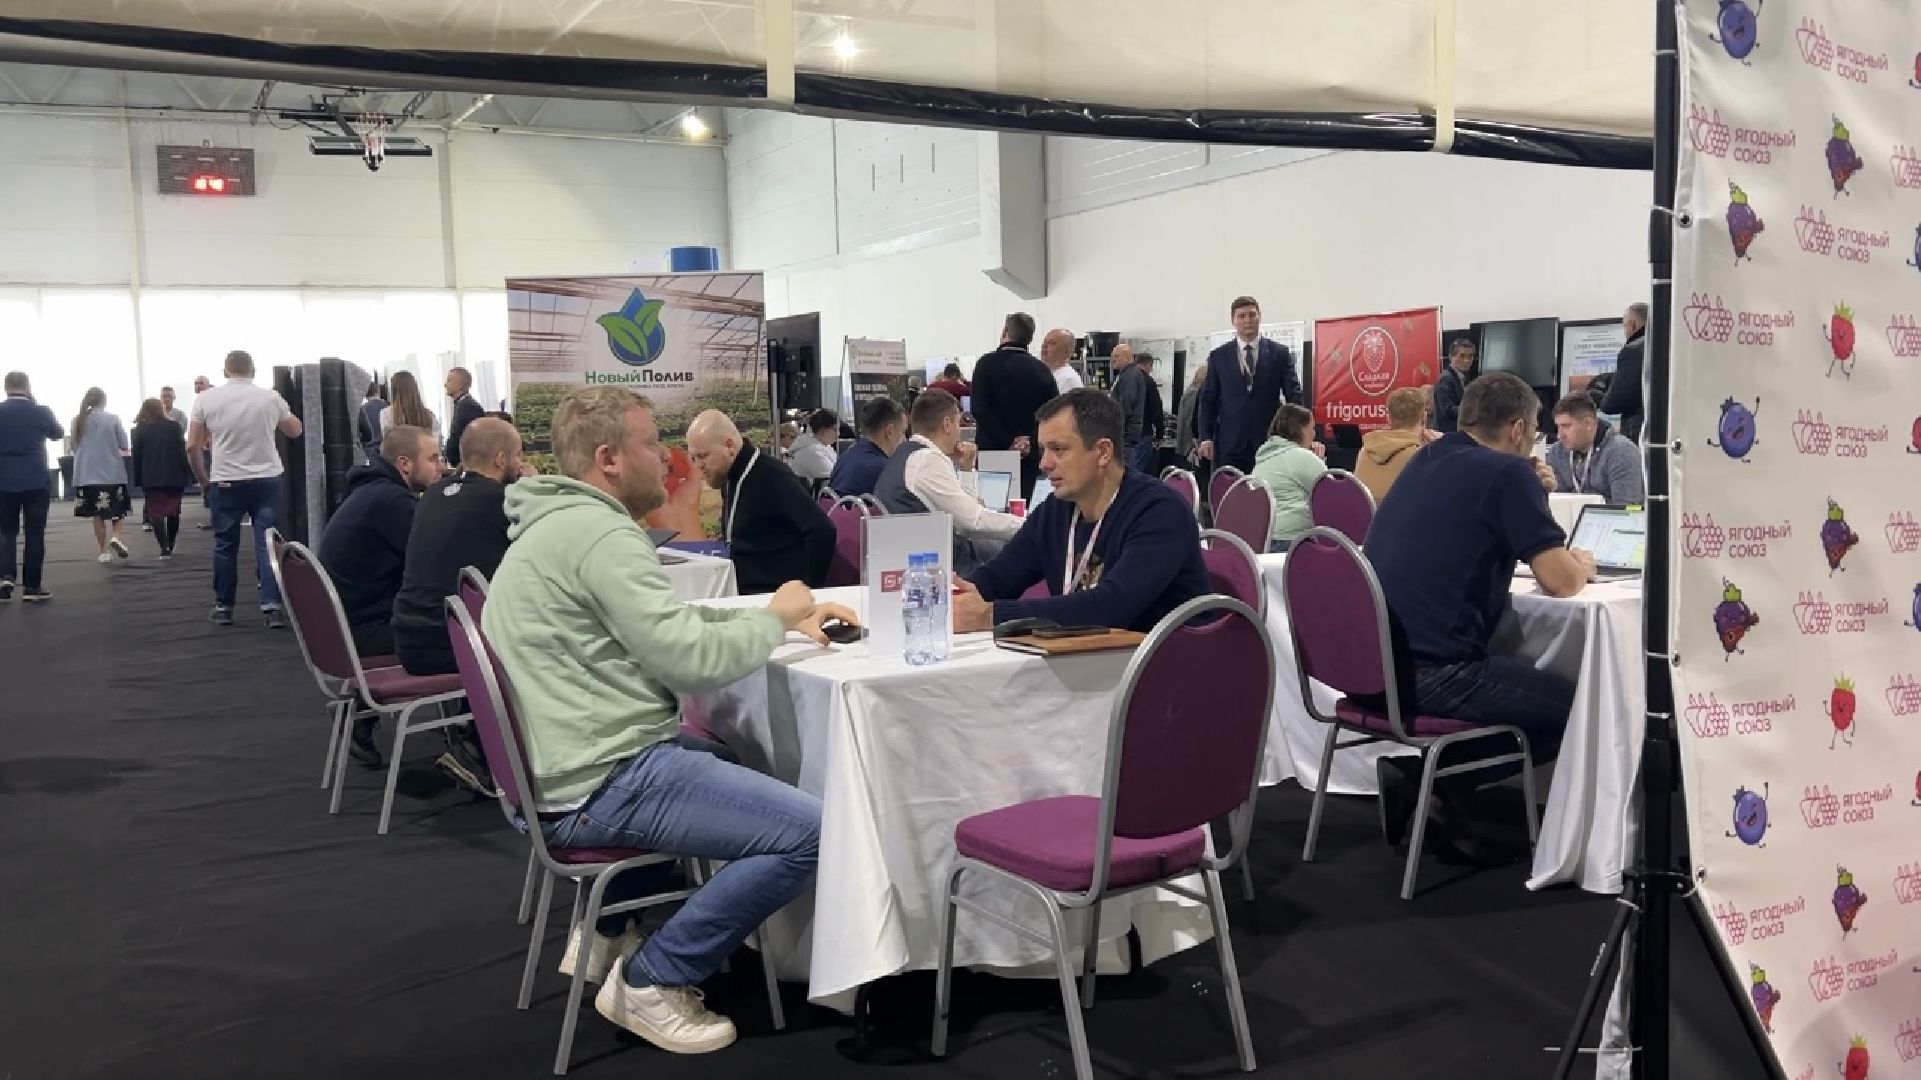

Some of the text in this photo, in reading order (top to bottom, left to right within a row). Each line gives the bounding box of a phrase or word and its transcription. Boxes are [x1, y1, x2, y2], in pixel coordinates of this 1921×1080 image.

[1837, 45, 1888, 70] ЯГОДНЫЙ
[1837, 63, 1867, 83] СОЮЗ
[1735, 129, 1796, 147] ЯГОДНЫЙ
[1734, 148, 1771, 164] СОЮЗ
[1838, 227, 1889, 248] ЯГОДНЫЙ
[1838, 245, 1870, 263] СОЮЗ
[1738, 310, 1794, 328] ЯГОДНЫЙ
[1737, 331, 1774, 345] СОЮЗ
[1836, 425, 1888, 442] ЯГОДНЫЙ
[1835, 444, 1867, 457] СОЮЗ
[1728, 520, 1792, 541] ЯГОДНЫЙ
[1728, 544, 1767, 558] СОЮЗ
[1835, 597, 1888, 616] ЯГОДНЫЙ
[1835, 619, 1865, 632] СОЮЗ
[1732, 693, 1795, 716] ЯГОДНЫЙ
[1735, 719, 1771, 734] СОЮЗ
[1843, 784, 1893, 807] ЯГОДНЫЙ
[1843, 807, 1874, 823] СОЮЗ
[1750, 896, 1805, 922] ЯГОДНЫЙ
[1752, 920, 1785, 940] СОЮЗ
[1847, 949, 1897, 975] ЯГОДНЫЙ
[1847, 974, 1877, 991] СОЮЗ
